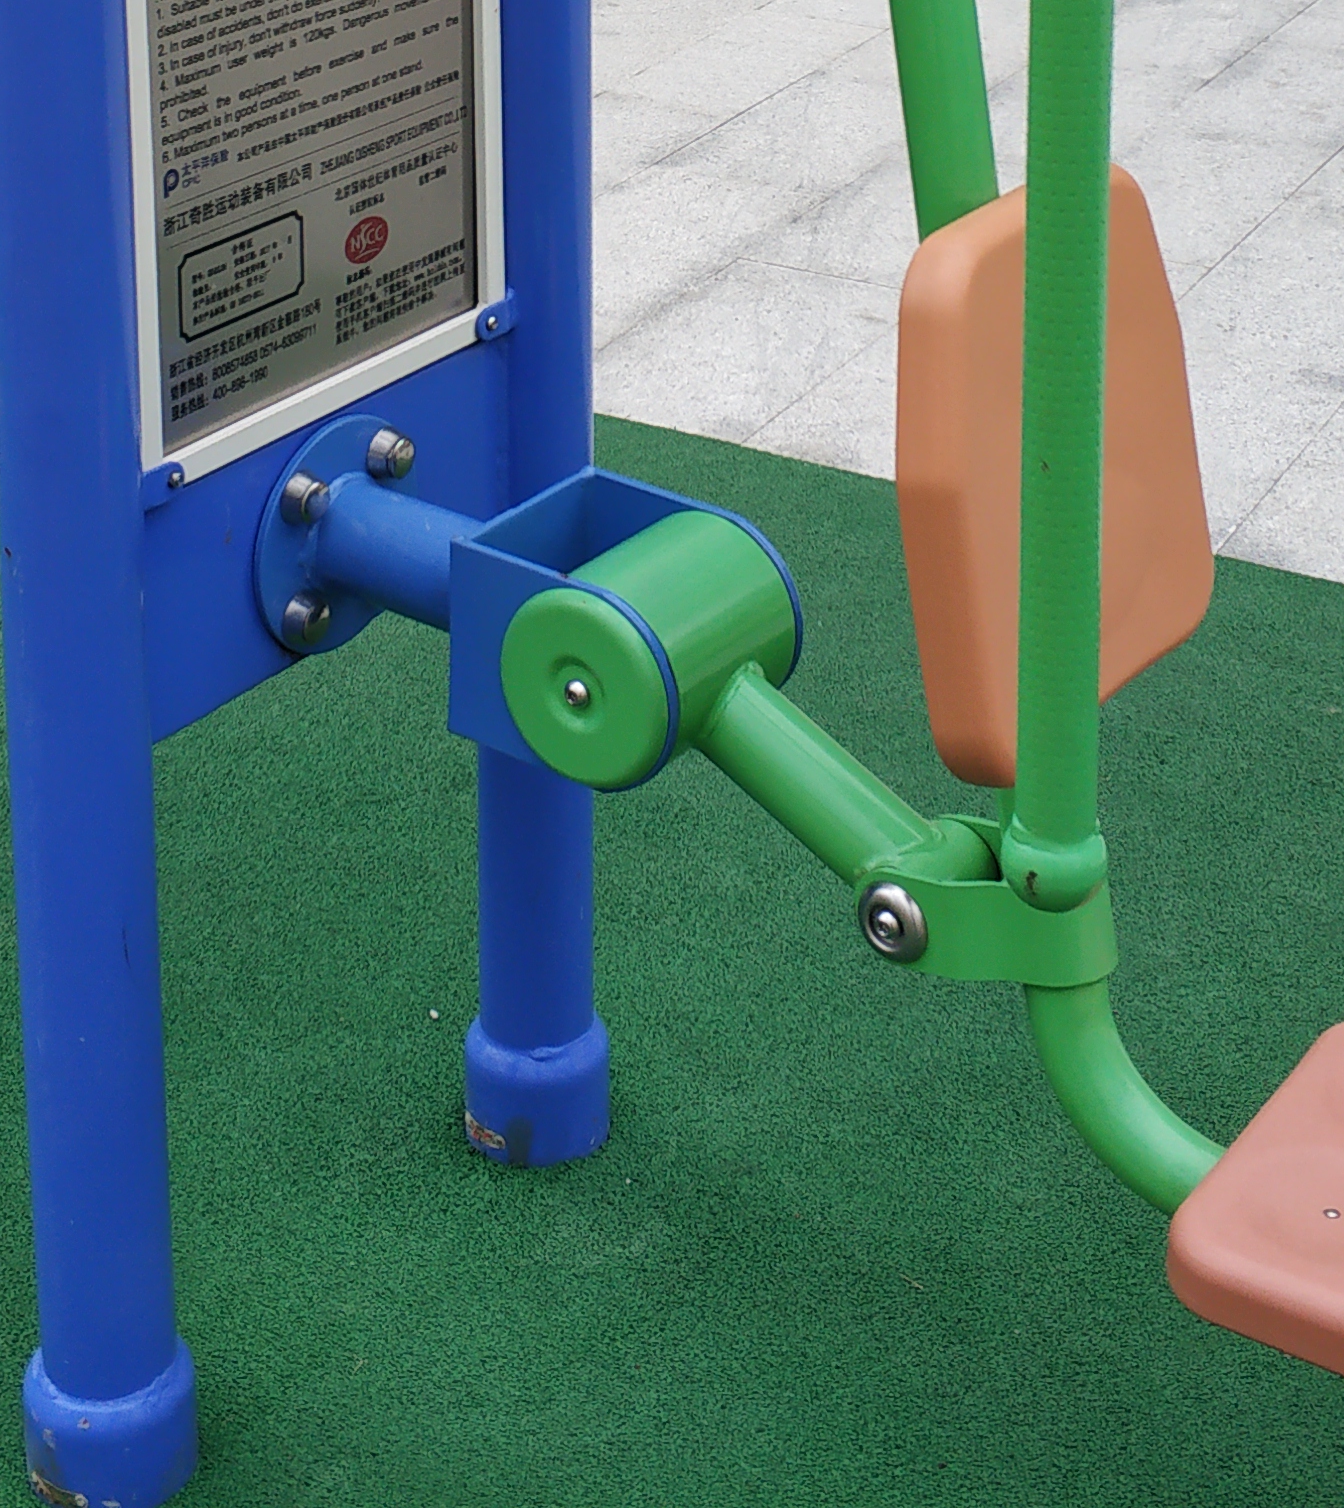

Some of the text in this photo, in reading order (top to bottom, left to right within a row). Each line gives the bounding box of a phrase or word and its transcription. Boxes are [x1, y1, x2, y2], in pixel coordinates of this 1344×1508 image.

[155, 6, 164, 21] 1.
[156, 15, 197, 39] disabled
[199, 6, 224, 25] must
[224, 2, 237, 17] be
[157, 60, 168, 75] 3.
[170, 56, 180, 71] In
[181, 50, 205, 67] case
[206, 44, 218, 59] of
[272, 13, 313, 37] withdraw
[314, 5, 337, 23] force
[169, 39, 179, 54] In
[180, 33, 205, 50] case
[206, 26, 217, 42] of
[290, 0, 303, 14] do
[158, 78, 169, 93] 4.
[174, 61, 222, 87] Maximum
[226, 54, 248, 70] user
[253, 40, 284, 64] weight
[288, 35, 297, 49] is
[342, 4, 389, 33] Dangerous
[177, 100, 209, 123] Check
[216, 92, 232, 109] the
[238, 73, 287, 104] equipment
[292, 60, 322, 82] before
[328, 46, 364, 69] exercise
[370, 38, 387, 54] and
[393, 28, 416, 46] make
[421, 22, 439, 36] sure
[445, 13, 458, 27] the
[160, 117, 212, 150] equipment
[213, 114, 222, 128] is
[223, 110, 233, 124] in
[234, 100, 258, 123] good
[173, 131, 220, 160] Maximum
[221, 124, 239, 142] two
[240, 113, 278, 137] persons
[279, 106, 289, 121] at
[290, 106, 297, 117] a
[321, 91, 338, 105] one
[340, 80, 369, 100] person
[371, 73, 380, 87] at
[381, 69, 398, 83] one
